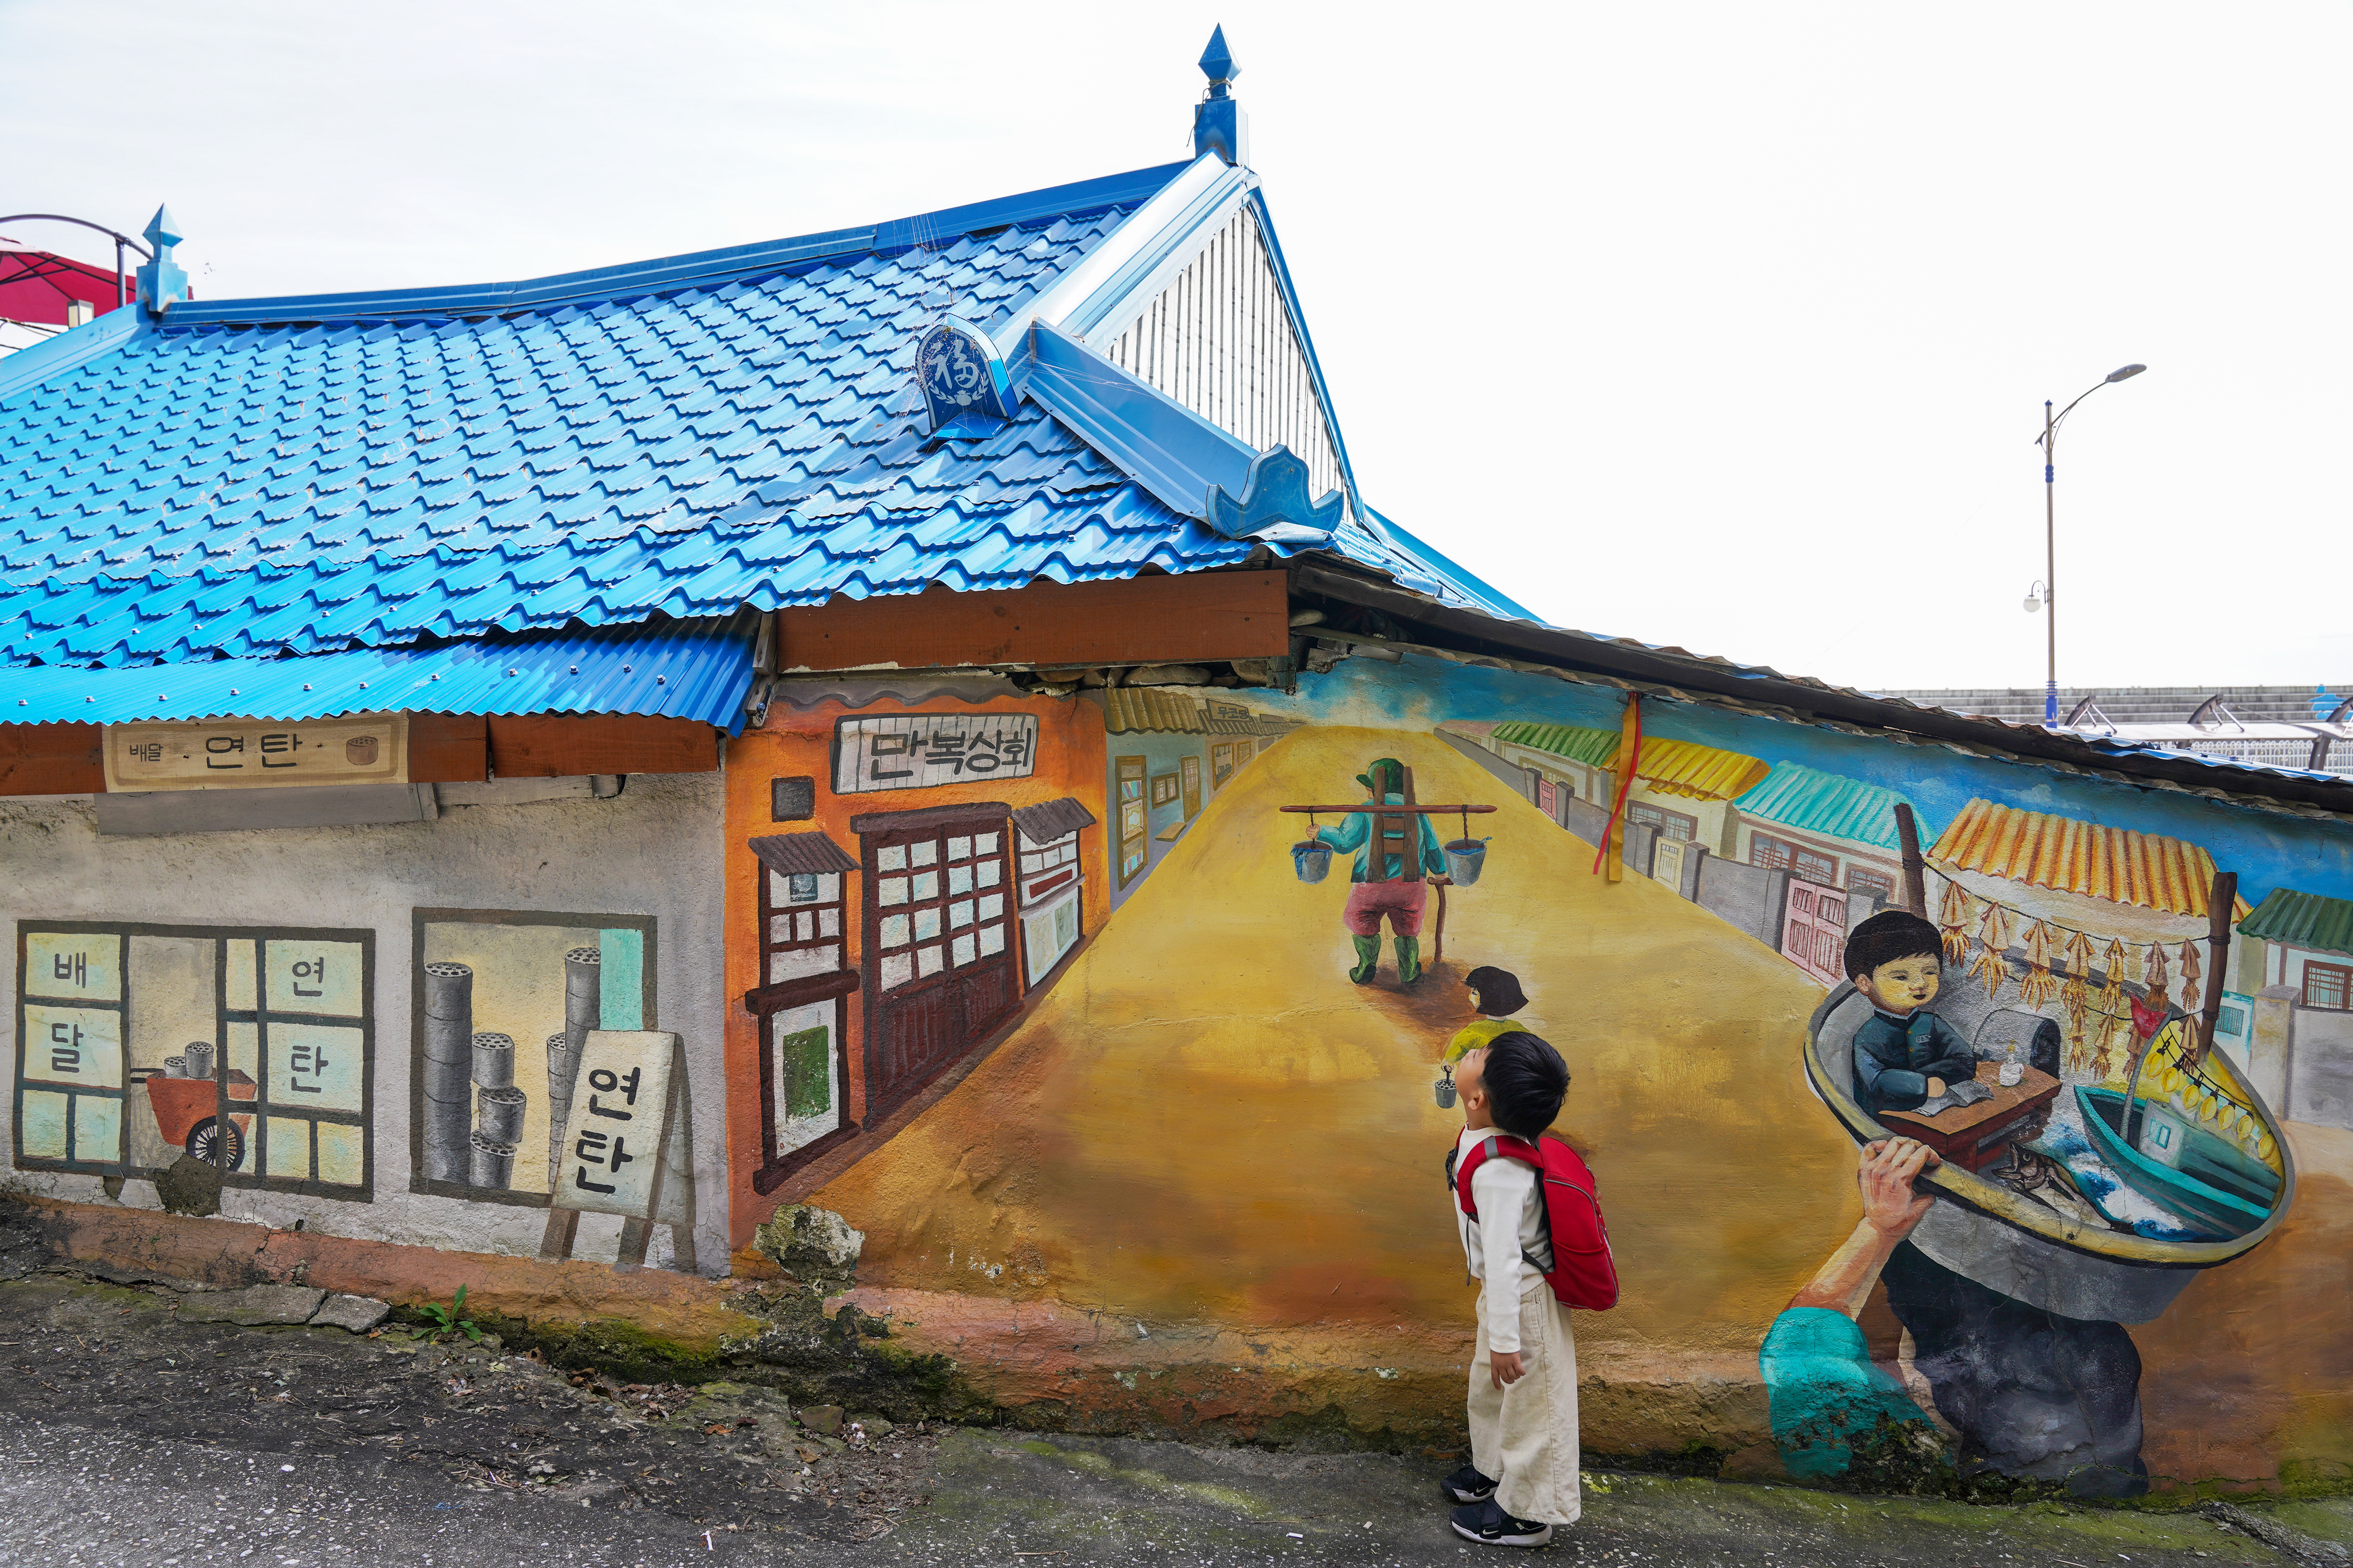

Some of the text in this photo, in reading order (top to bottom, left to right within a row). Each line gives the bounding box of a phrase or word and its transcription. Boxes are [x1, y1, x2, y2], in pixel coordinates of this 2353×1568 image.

[130, 734, 303, 769] 배달 연탄
[871, 728, 1031, 780] 만복상회
[576, 1066, 641, 1194] 연탄
